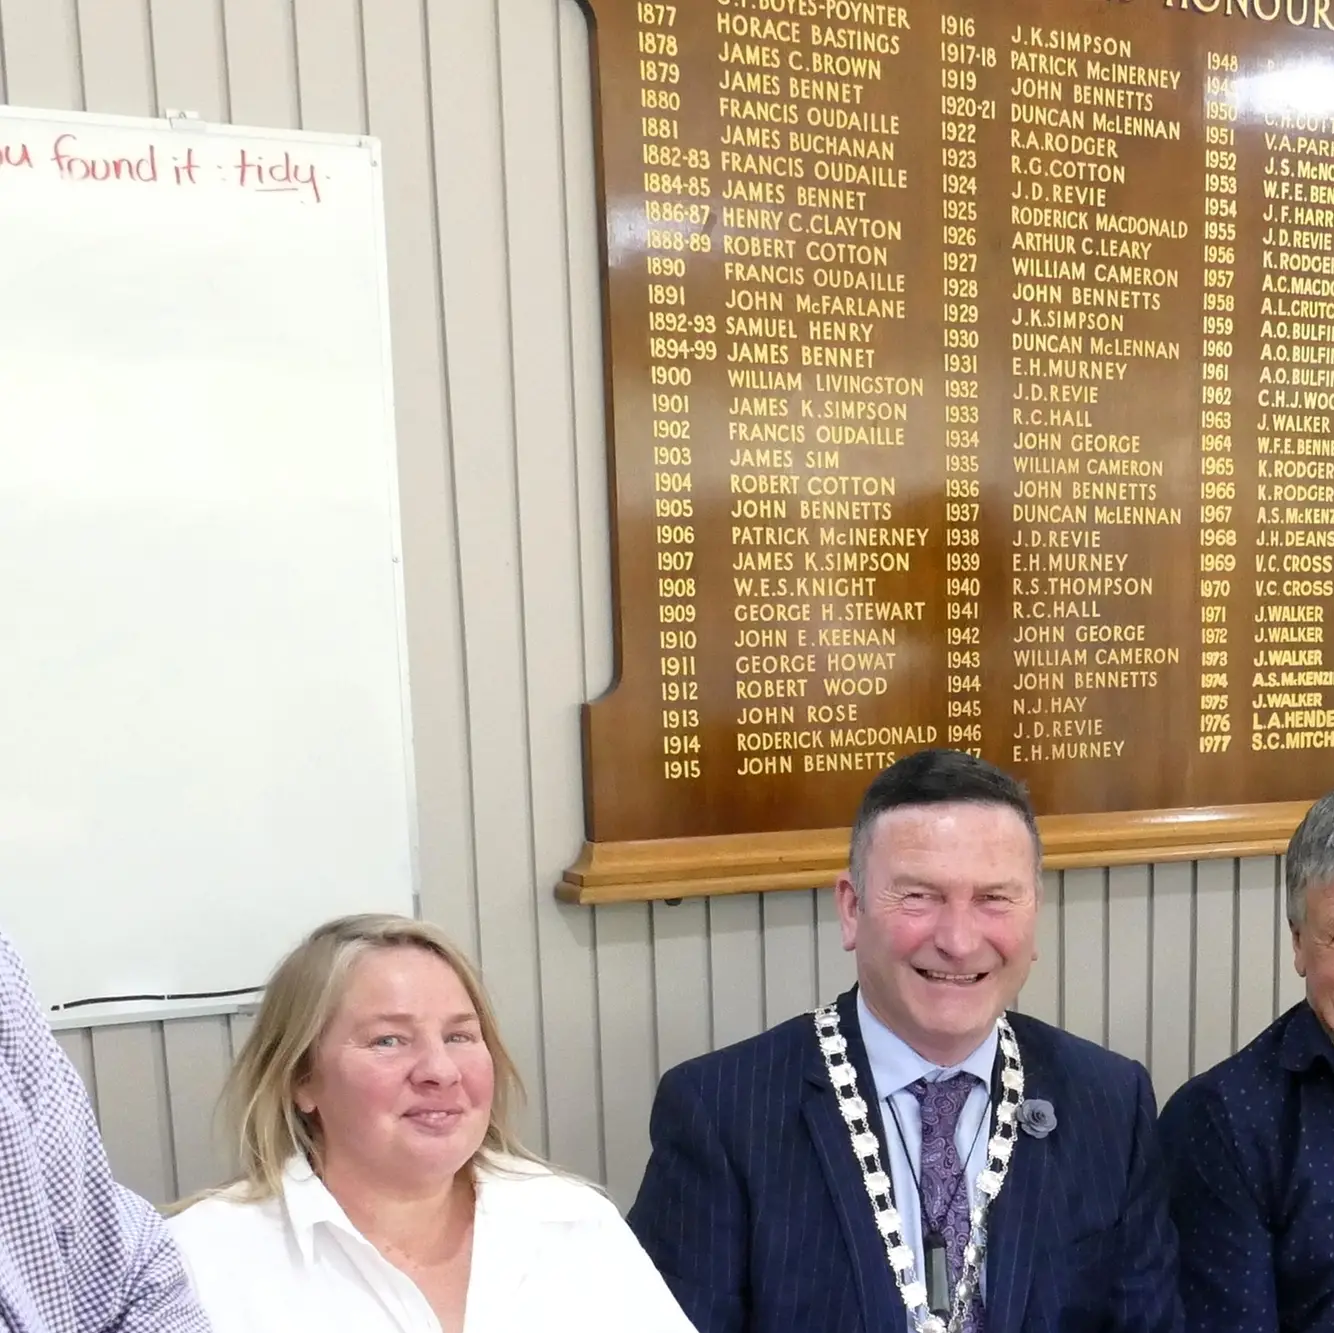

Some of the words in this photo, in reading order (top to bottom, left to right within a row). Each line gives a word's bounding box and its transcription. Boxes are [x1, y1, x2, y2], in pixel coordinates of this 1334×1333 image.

[638, 2, 676, 26] 1877
[717, 12, 800, 43] HORACE
[812, 25, 899, 55] BASTINGS
[942, 15, 975, 37] 1916
[941, 42, 996, 67] 1917-18
[1011, 50, 1078, 77] PATRICK
[640, 60, 680, 84] 1879
[719, 70, 780, 95] JAMES
[790, 77, 863, 104] BENNET
[942, 96, 995, 119] 1920-21
[1011, 103, 1084, 129] DUNCAN
[52, 134, 158, 182] found
[172, 148, 200, 185] it
[643, 144, 710, 169] 1882-83
[1206, 149, 1236, 171] 1952
[644, 173, 710, 196] 1884-85
[943, 174, 977, 195] 1924
[723, 207, 783, 230] HENRY
[1012, 231, 1076, 254] ARTHUR
[1204, 245, 1234, 264] 1956
[648, 256, 685, 277] 1890
[725, 289, 782, 311] JOHN
[649, 312, 716, 333] 1892-93
[726, 316, 797, 338] SAMUEL
[809, 321, 873, 342] HENRY
[1203, 316, 1233, 335] 1959
[1013, 333, 1082, 354] DUNCAN
[728, 370, 801, 391] WILLIAM
[817, 374, 923, 396] LIVINGSTON
[1202, 410, 1231, 429] 1963
[1014, 432, 1061, 450] JOHN
[1071, 434, 1139, 453] GEORGE
[654, 447, 691, 465] 1903
[731, 449, 792, 467] JAMES
[806, 451, 838, 468] SIM
[946, 479, 979, 497] 1936
[657, 525, 694, 544] 1906
[732, 527, 809, 545] PATRICK
[947, 577, 980, 596] 1940
[660, 604, 696, 623] 1909
[735, 604, 810, 621] GEORGE
[1013, 649, 1087, 667] WILLIAM
[1096, 648, 1178, 664] CAMERON
[948, 675, 981, 693] 1944
[737, 730, 824, 751] RODERICK
[830, 726, 937, 747] MACDONALD
[1200, 735, 1231, 753] 1977
[665, 760, 700, 779] 1915
